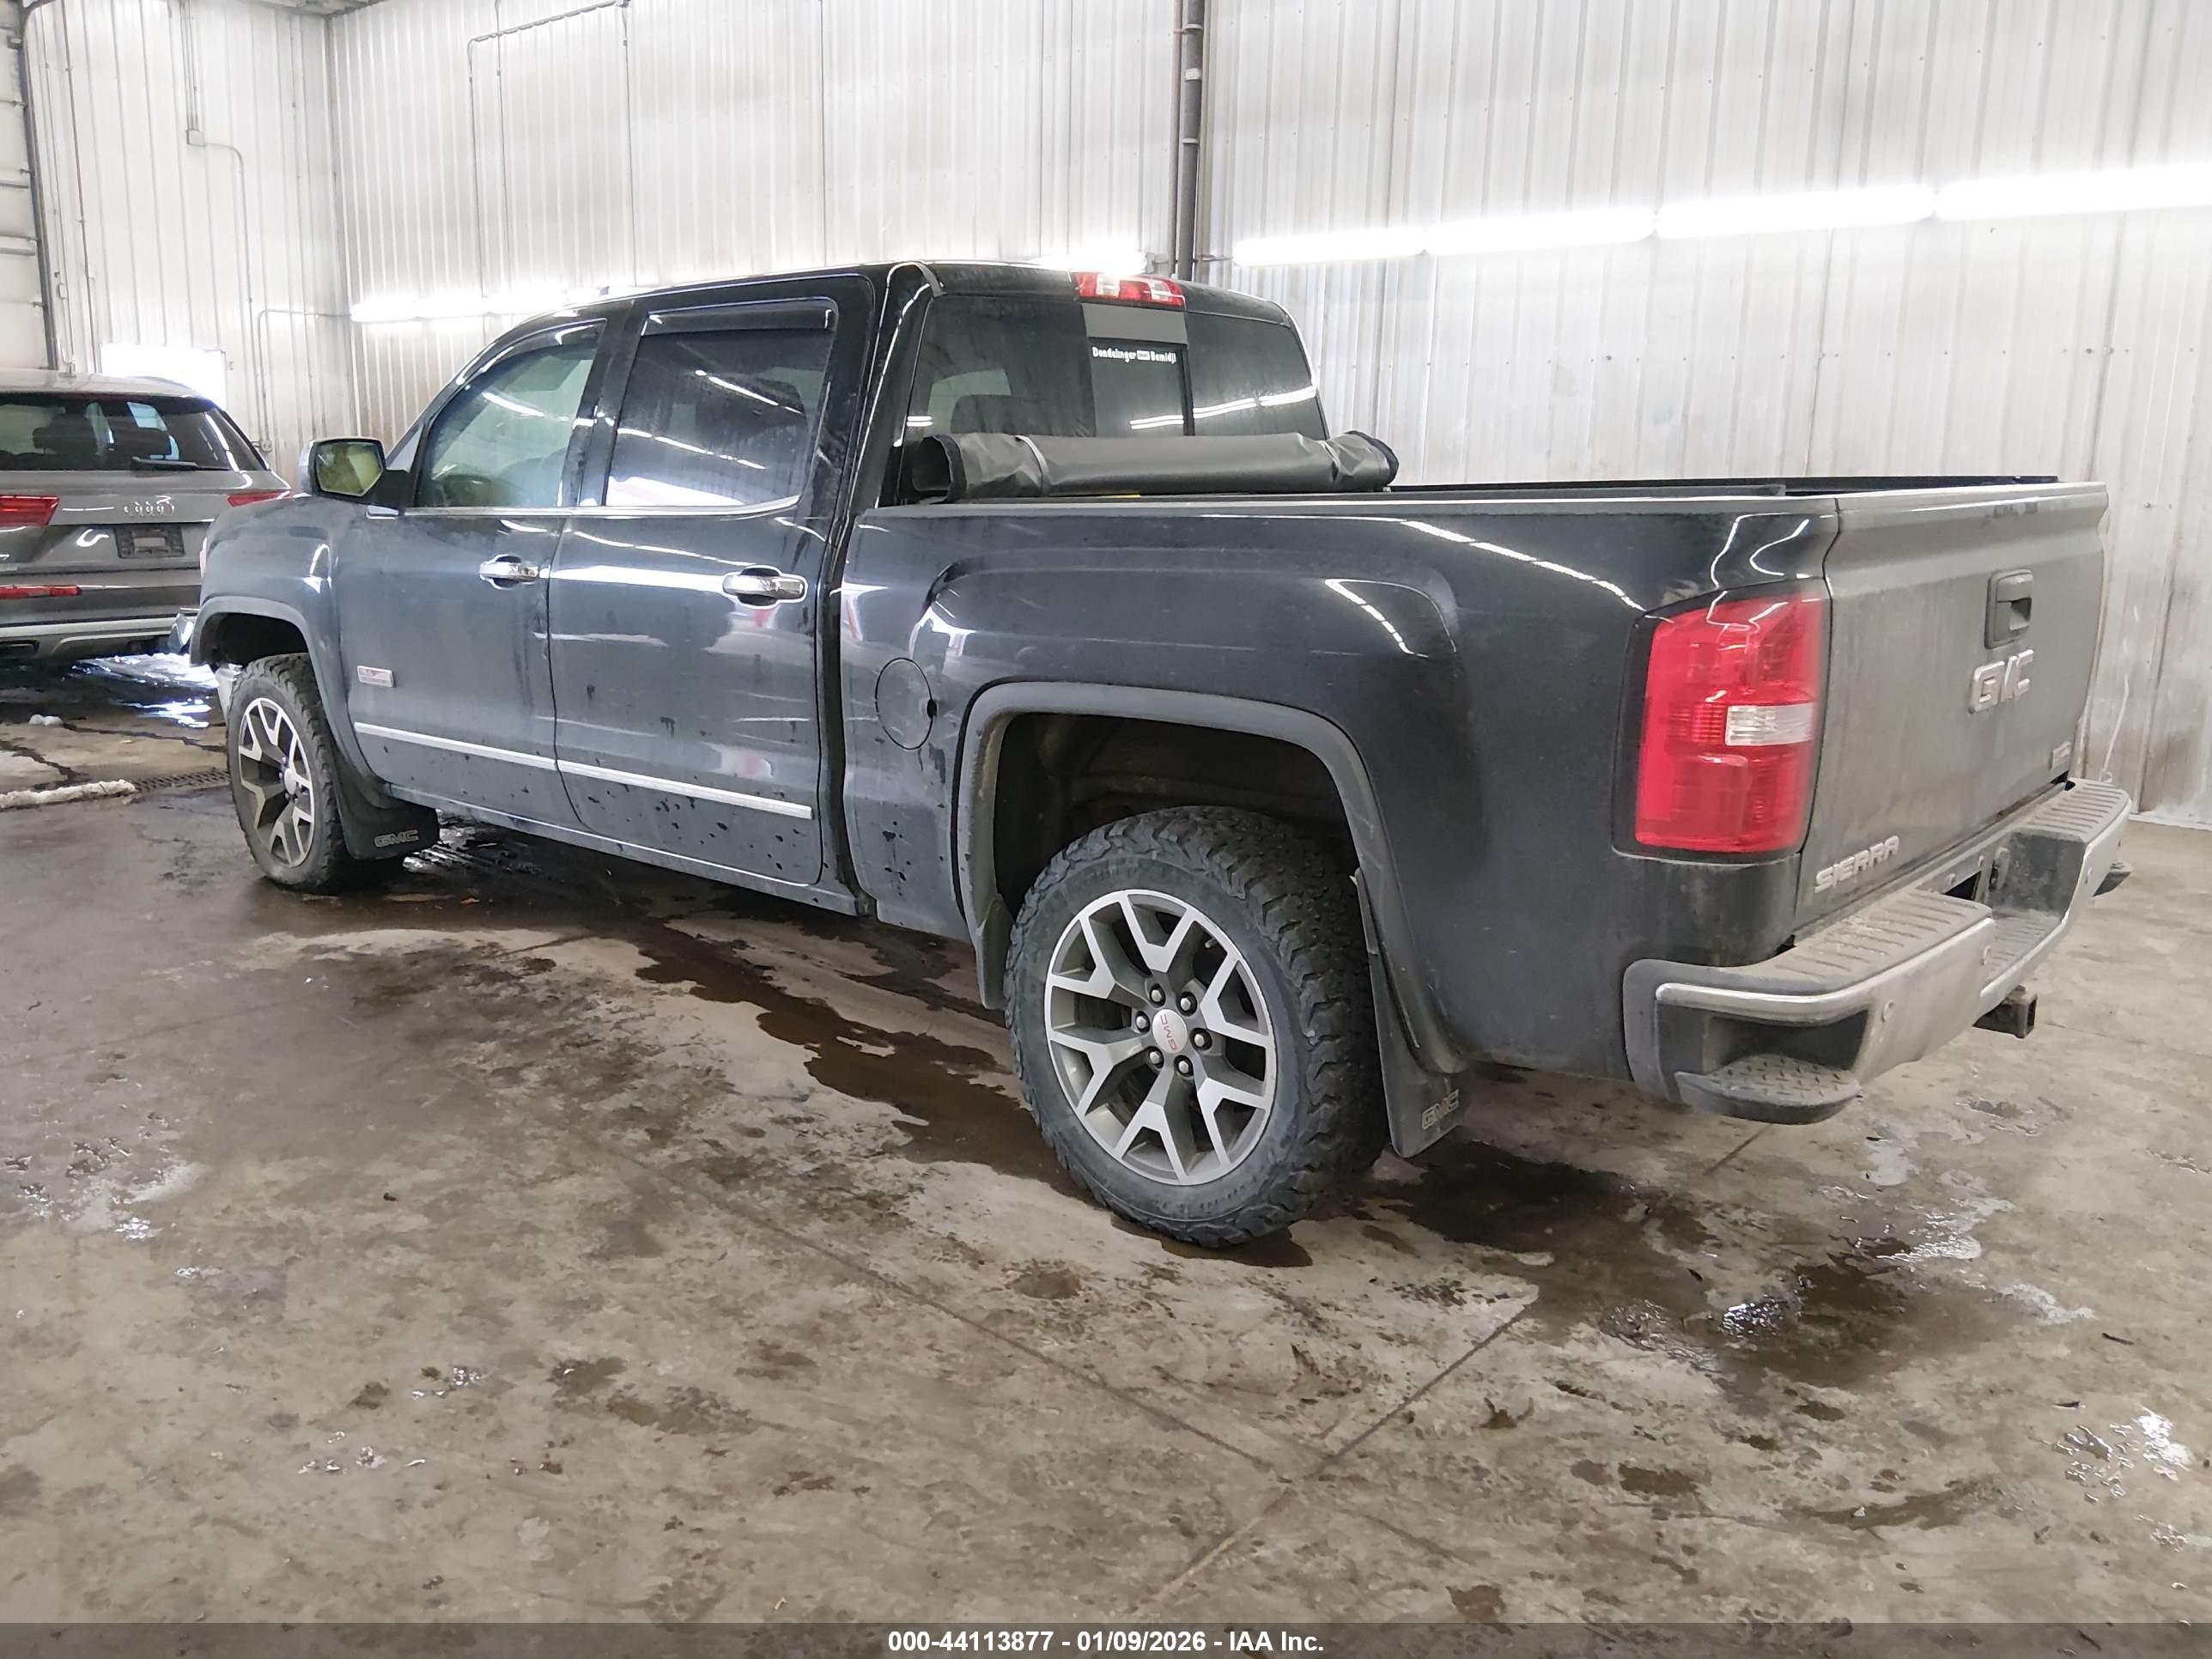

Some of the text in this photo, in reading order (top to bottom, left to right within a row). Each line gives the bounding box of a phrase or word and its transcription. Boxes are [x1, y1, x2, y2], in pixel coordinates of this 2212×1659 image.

[1973, 649, 2034, 712] GMC
[374, 830, 419, 847] GMC
[1814, 836, 1899, 893] SIERRA
[1160, 1013, 1177, 1051] GMC
[1421, 1089, 1460, 1129] GMC
